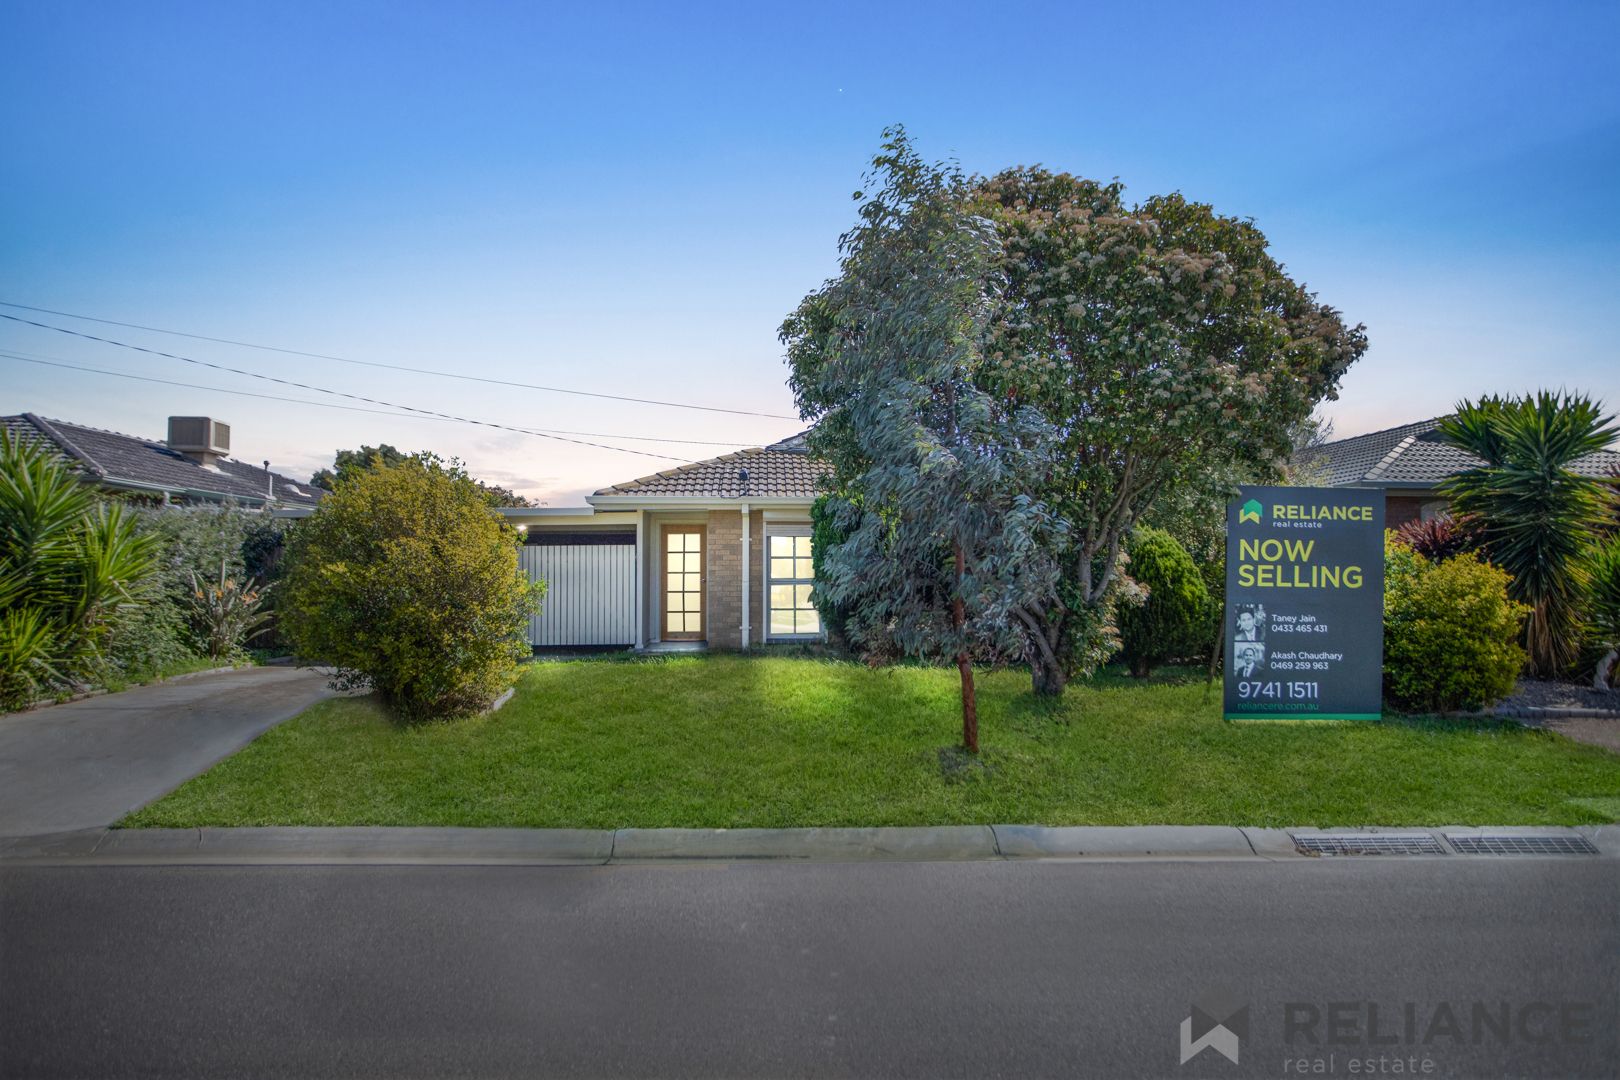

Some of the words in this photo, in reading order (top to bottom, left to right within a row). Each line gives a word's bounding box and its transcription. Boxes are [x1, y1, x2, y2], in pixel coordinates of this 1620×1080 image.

[1272, 504, 1373, 521] RELIANCE
[1272, 520, 1291, 528] real
[1293, 521, 1323, 529] estate
[1239, 538, 1315, 562] NOW
[1237, 564, 1363, 589] SELLING
[1271, 614, 1297, 623] Taney
[1299, 614, 1316, 622] Jain
[1271, 625, 1294, 633] 0433
[1295, 625, 1312, 633] 465
[1313, 625, 1328, 633] 431
[1271, 651, 1296, 659] Akash
[1298, 651, 1343, 661] Chaudhary
[1270, 661, 1293, 670] 0469
[1294, 661, 1311, 670] 259
[1312, 661, 1329, 670] 963
[1238, 681, 1281, 698] 9741
[1286, 681, 1319, 698] 1511
